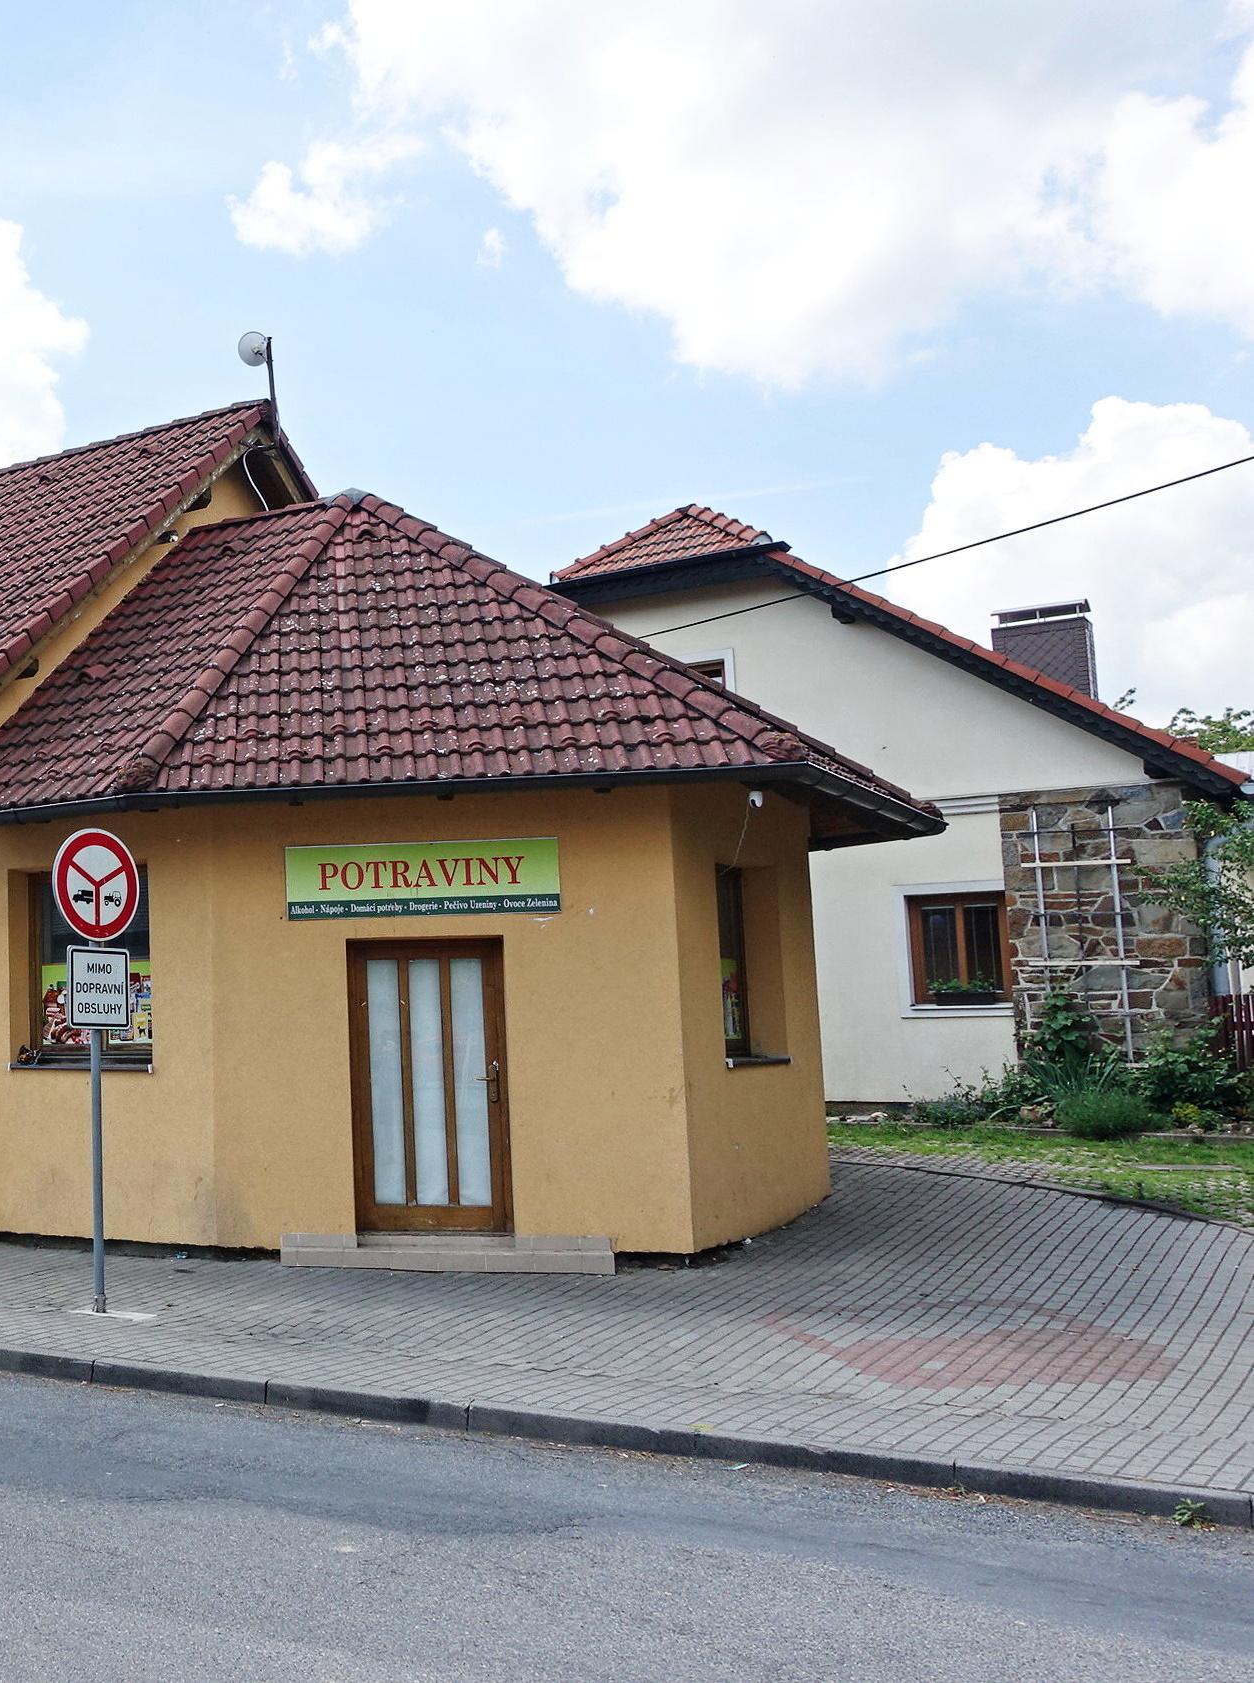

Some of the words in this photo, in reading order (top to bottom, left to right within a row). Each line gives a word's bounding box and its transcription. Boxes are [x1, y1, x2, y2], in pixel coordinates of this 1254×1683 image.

[318, 856, 524, 890] POTRAVINY
[290, 904, 315, 915] Alkohol
[320, 903, 344, 915] Nápoje
[350, 902, 376, 913] Domácí
[377, 902, 403, 914] potřeby
[409, 901, 438, 913] Drogerie
[443, 899, 469, 910] Pečivo
[469, 899, 497, 911] Uzeniny
[503, 898, 526, 908] Ovoce
[526, 897, 558, 908] Zelenina
[86, 962, 112, 974] MIMO
[75, 981, 124, 995] DOPRAVNÍ
[77, 1002, 123, 1015] OBSLUHY
